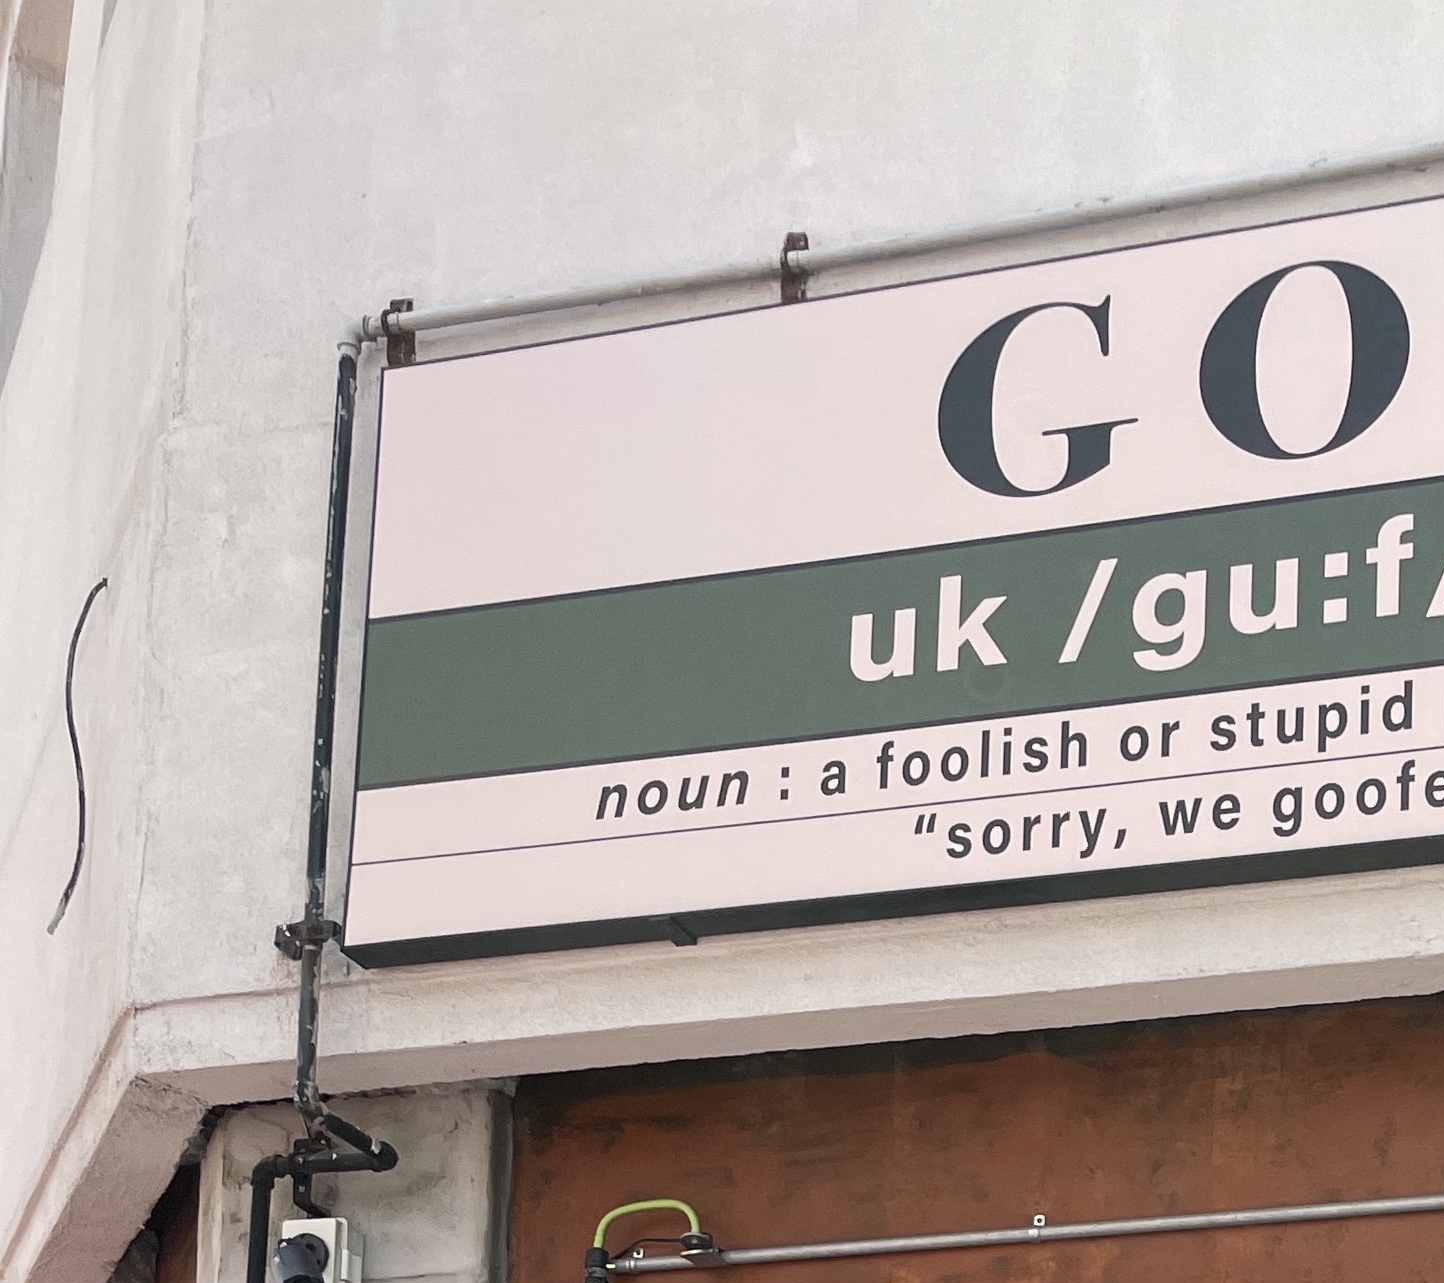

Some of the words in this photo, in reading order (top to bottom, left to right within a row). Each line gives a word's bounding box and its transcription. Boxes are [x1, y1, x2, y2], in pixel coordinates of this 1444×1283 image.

[850, 574, 1008, 682] uk
[596, 769, 749, 820] noun
[820, 760, 847, 797] a
[877, 720, 1087, 789] foolish
[1120, 720, 1181, 762] or
[1210, 680, 1413, 753] stupid
[1159, 794, 1241, 836] we
